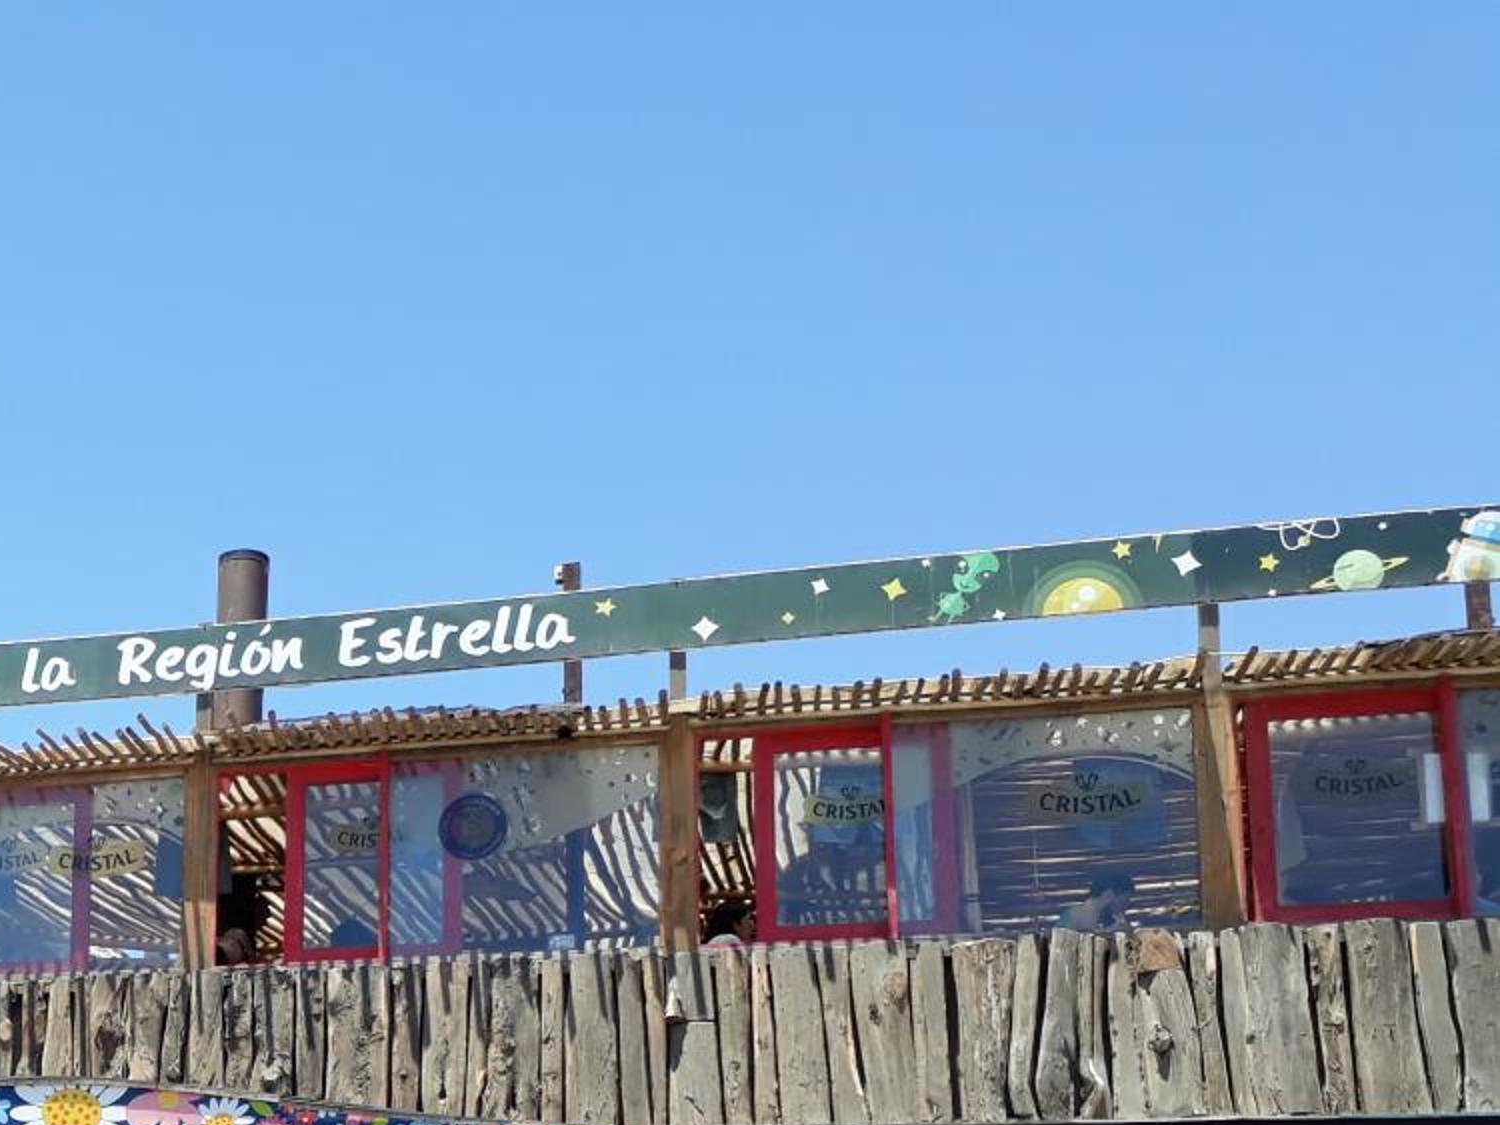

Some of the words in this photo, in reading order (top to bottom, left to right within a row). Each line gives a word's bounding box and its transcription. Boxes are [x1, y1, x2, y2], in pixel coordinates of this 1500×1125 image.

[22, 648, 77, 693] la
[116, 624, 305, 692] Región
[338, 603, 577, 668] Estrella
[1315, 772, 1404, 796] CRISTAL
[812, 800, 885, 820] CRISTA
[1039, 792, 1141, 815] CRISTAL
[58, 849, 135, 871] CRISTAL
